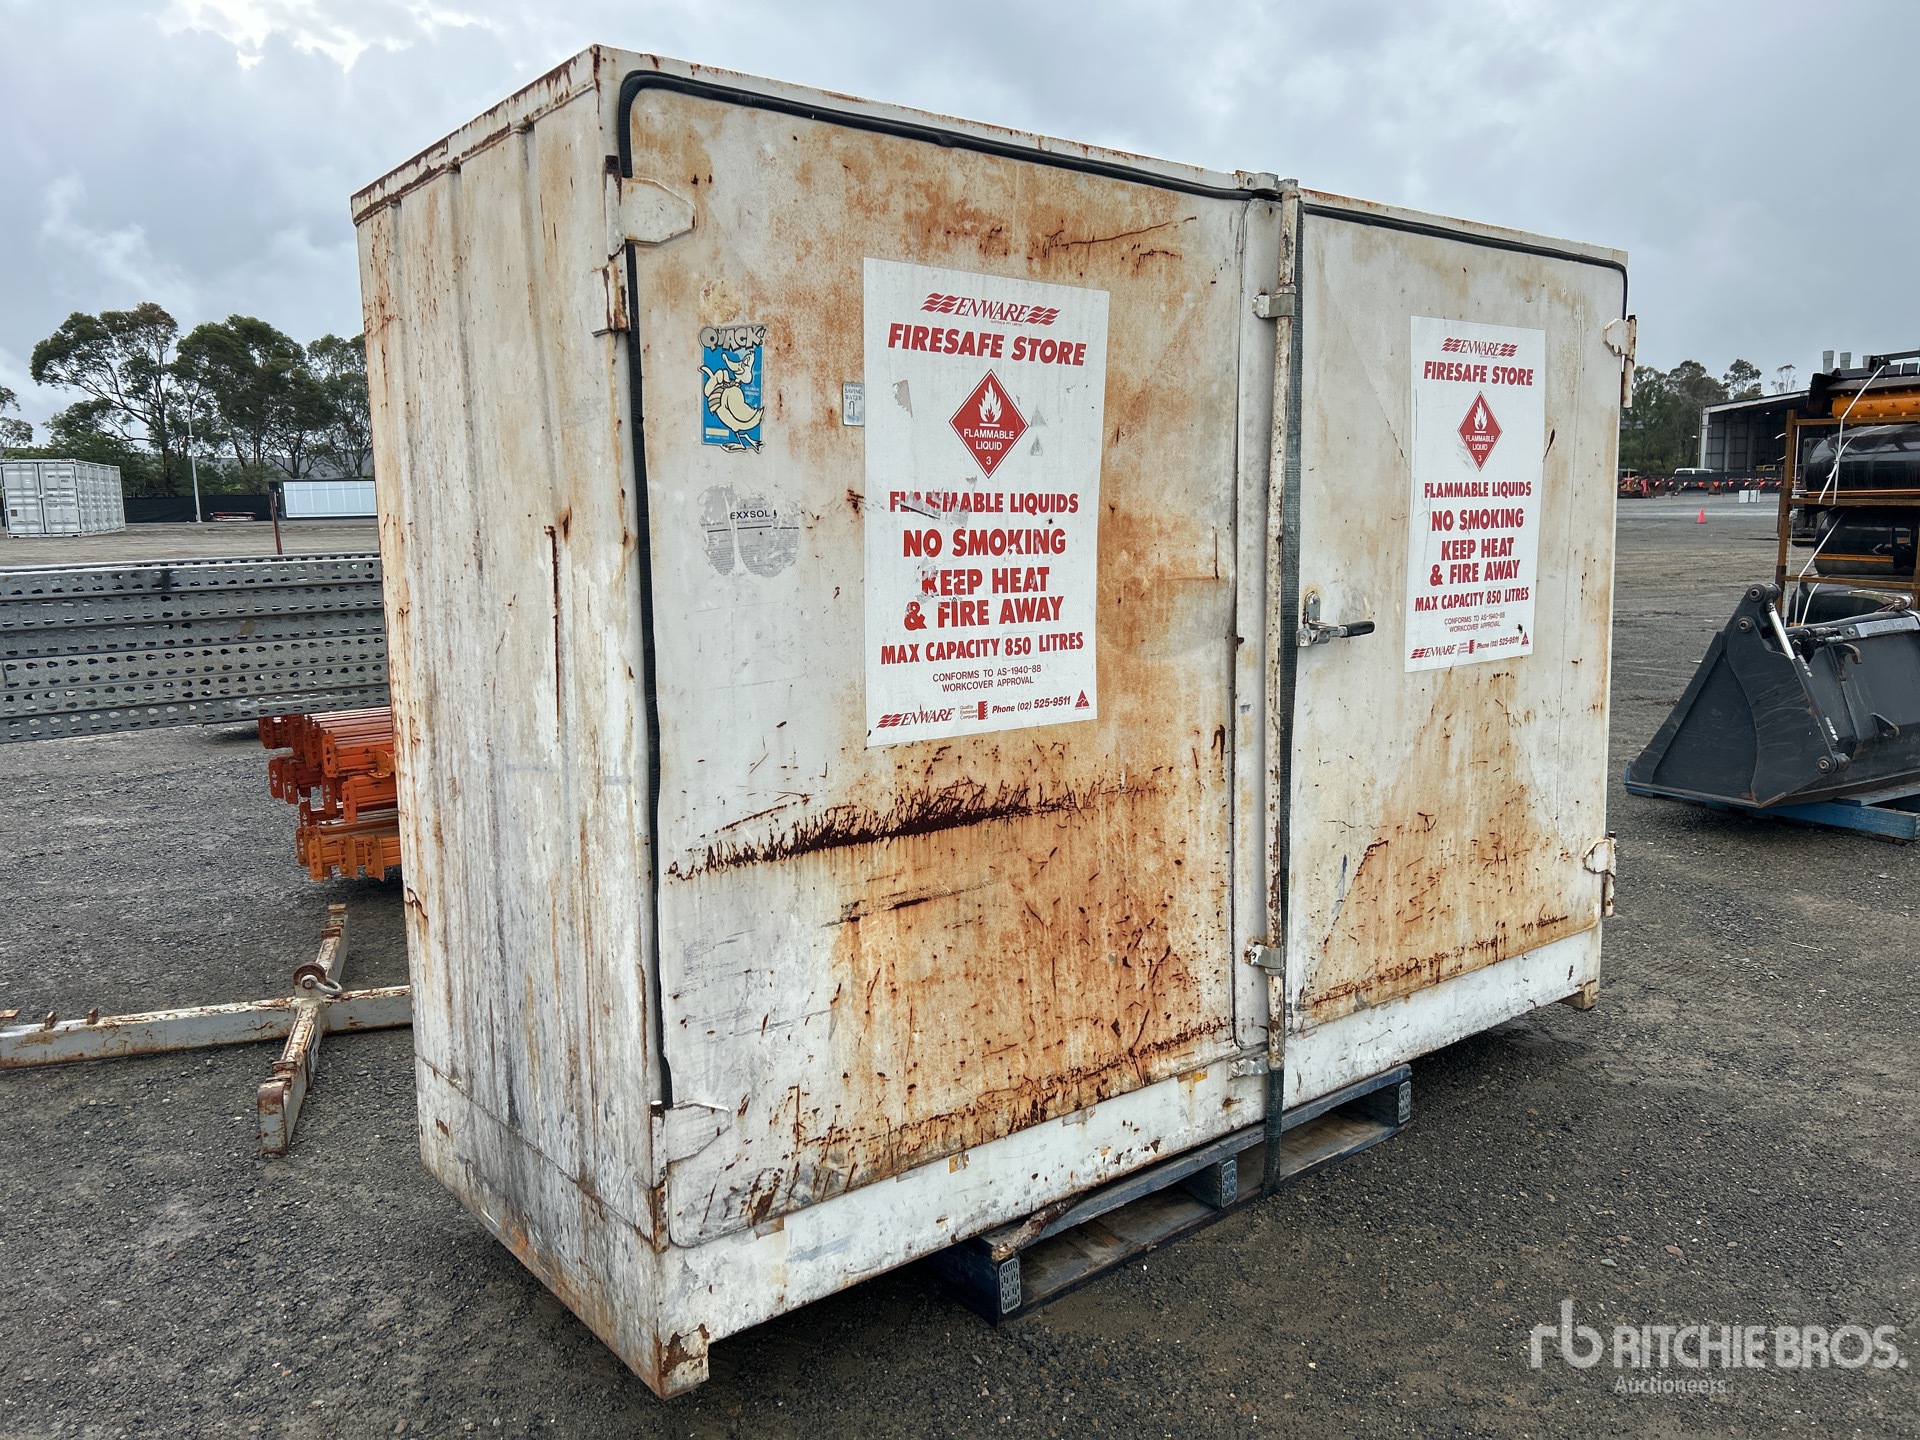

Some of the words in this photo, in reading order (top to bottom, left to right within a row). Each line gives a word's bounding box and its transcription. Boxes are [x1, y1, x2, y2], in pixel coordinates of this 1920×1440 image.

[953, 296, 1030, 323] ENWARE
[888, 323, 1005, 359] FIRESAFE
[1011, 336, 1087, 366] STORE
[1459, 339, 1501, 356] ENWARE
[1423, 360, 1487, 383] FIRESAFE
[1491, 365, 1534, 386] STORE
[963, 428, 1015, 440] FLAMMABLE
[1465, 434, 1495, 442] FLAMMABLE
[975, 441, 1003, 450] LIQUID
[986, 456, 992, 465] 3
[1424, 482, 1489, 499] FLAMMABLE
[1492, 481, 1532, 498] LIQUIDS
[1010, 492, 1079, 516] LIQUIDS
[730, 510, 771, 520] EXXSOL
[1431, 509, 1454, 532] NO
[1459, 508, 1524, 531] SMOKING
[903, 528, 943, 557] NO
[952, 528, 1066, 557] SMOKING
[1441, 539, 1476, 561] KEEP
[1481, 537, 1514, 559] HEAT
[921, 568, 983, 596] KEEP
[992, 566, 1050, 594] HEAT
[1429, 564, 1444, 586] &
[1450, 562, 1479, 584] FIRE
[1484, 559, 1520, 581] AWAY
[1415, 596, 1438, 612] MAX
[1441, 591, 1484, 609] CAPACITY
[1486, 590, 1500, 604] 850
[1504, 587, 1529, 603] LITRES
[903, 601, 927, 631] &
[938, 599, 990, 628] FIRE
[999, 595, 1064, 625] AWAY
[1444, 616, 1472, 625] CONFORMS
[1449, 623, 1479, 633] WORKCOVER
[1480, 621, 1501, 629] APPROVAL
[881, 643, 920, 665] MAX
[926, 637, 1001, 662] CAPACITY
[1005, 636, 1031, 657] 850
[1039, 631, 1084, 653] LITRES
[1424, 645, 1456, 658] ENWARE
[932, 669, 980, 682] CONFORMS
[983, 668, 994, 677] TO
[997, 664, 1042, 676] AS-1940-88
[942, 680, 993, 693] WORKCOVER
[997, 676, 1034, 687] APPROVAL
[992, 705, 1016, 714] Phone
[1017, 701, 1032, 712] (02)
[1033, 695, 1071, 709] 525-9511
[900, 707, 955, 727] ENWARE
